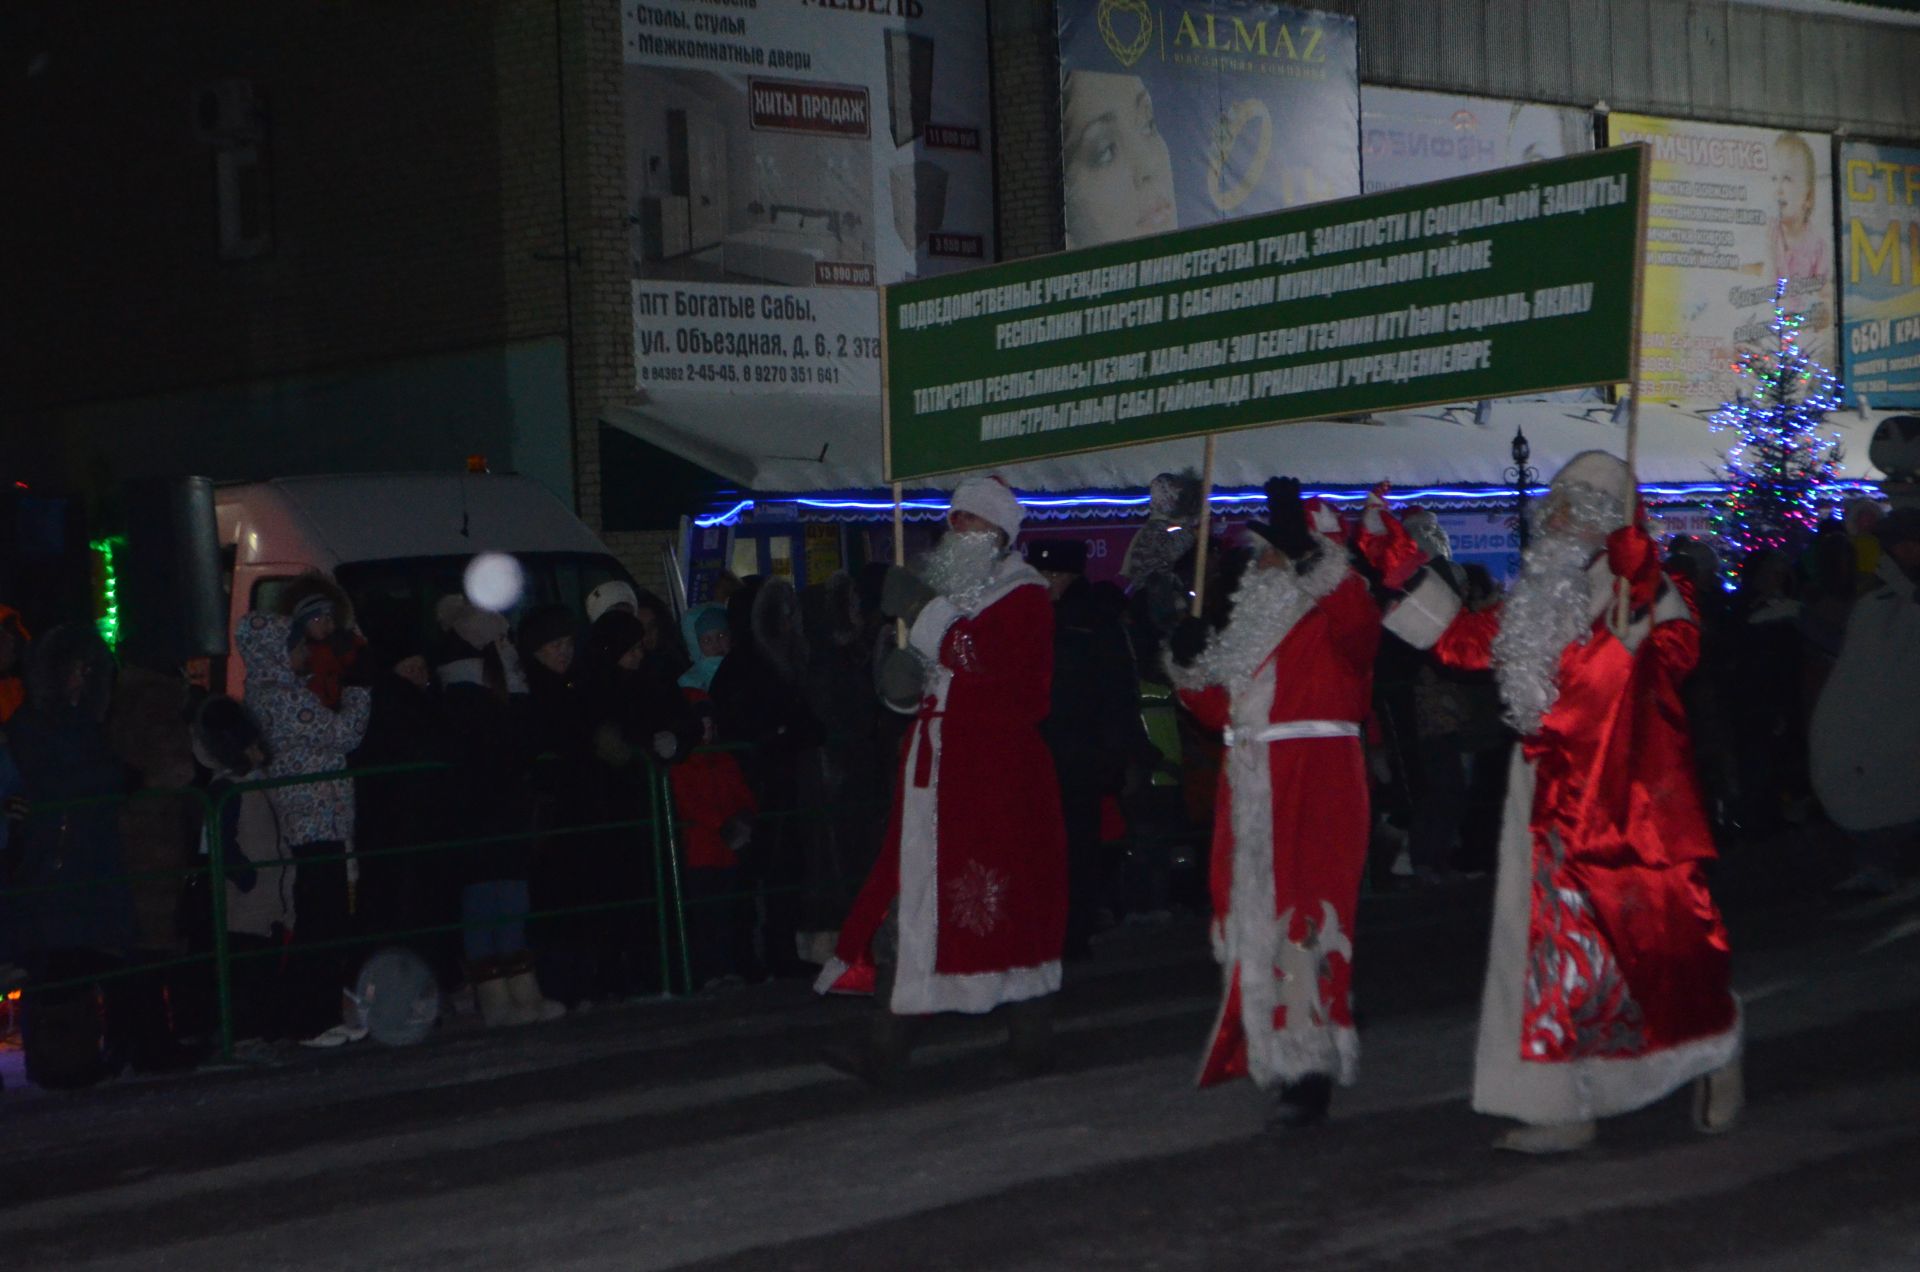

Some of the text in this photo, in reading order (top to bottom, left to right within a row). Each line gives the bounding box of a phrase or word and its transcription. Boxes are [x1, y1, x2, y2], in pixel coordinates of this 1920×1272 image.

[694, 14, 746, 36] стулья
[1173, 10, 1327, 63] ALMAZ
[639, 33, 812, 70] Межкомнатные двери
[754, 90, 866, 123] ХИТЫ ПРОДАЖ
[899, 173, 1627, 330] ПОДВЕДОМСТВЕННЫЕ УЧРЕЖДЕНИЯ МИНИСТЕРСТВА ТРУДА, ЗАНЯТОСТИ И СОЦИАЛЬНОЙ ЗАЩИТЫ
[640, 291, 817, 323] пгт Богатые Сабы,
[996, 239, 1492, 350] РЕСПУБЛИКИ ТАТАРСТАН В САБИНСКОМ МУНИЦИПАЛЬНОМ РАЙОНЕ
[641, 331, 670, 356] ул.
[676, 329, 788, 359] Объездная,
[792, 338, 809, 360] д.
[836, 335, 849, 357] 2
[853, 336, 881, 360] эта
[913, 379, 984, 415] ТАТАРСТАН
[985, 360, 1093, 403] РЕСПУБЛИКАСЫ
[1229, 333, 1257, 364] ЭШ
[1447, 292, 1531, 332] СОЦИАЛЬ
[1852, 318, 1890, 355] ОБОИ
[755, 365, 787, 383] 9270
[790, 366, 812, 384] 351
[817, 367, 839, 384] 641
[1117, 388, 1155, 420] САБА
